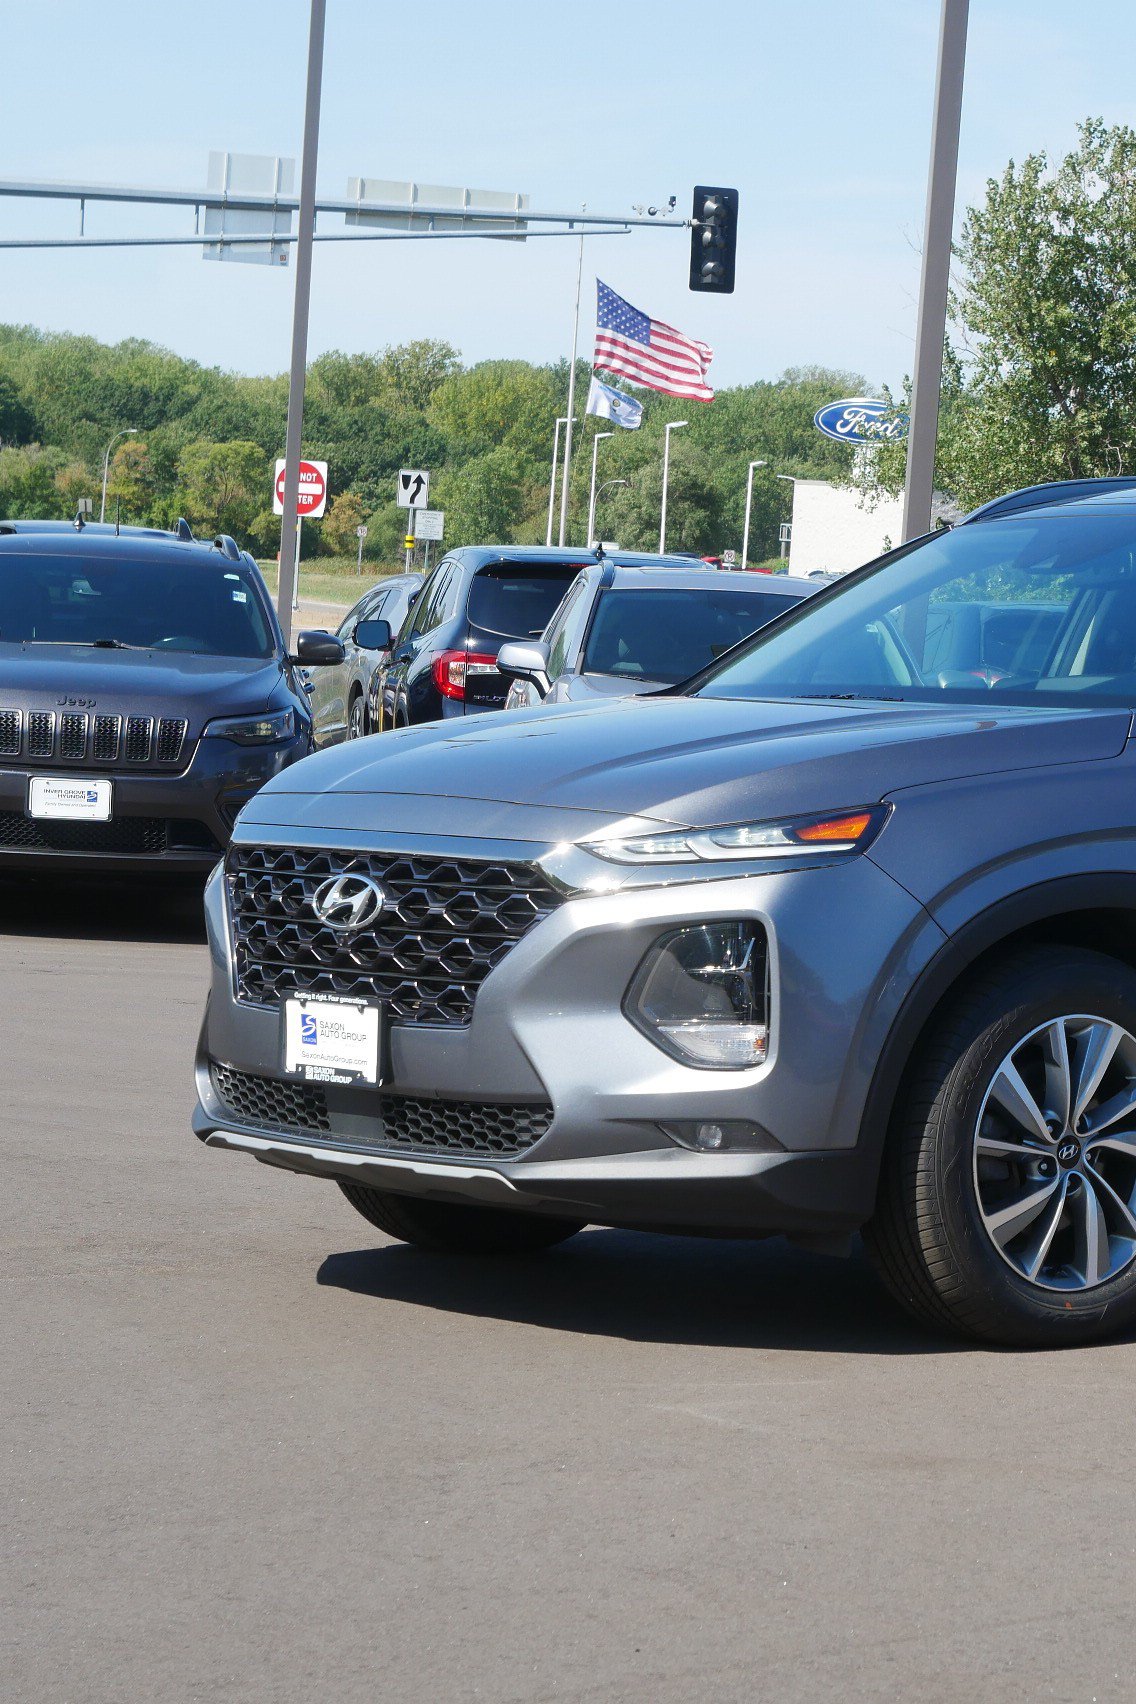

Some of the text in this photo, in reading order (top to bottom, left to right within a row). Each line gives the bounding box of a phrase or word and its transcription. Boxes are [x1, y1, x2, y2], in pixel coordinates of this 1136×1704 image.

[300, 472, 317, 482] NOT
[298, 495, 313, 505] TER
[56, 695, 97, 709] Jeep
[319, 1020, 345, 1031] SAXON
[319, 1030, 367, 1042] AUTO GROUP
[313, 1066, 335, 1075] SAXON
[313, 1073, 353, 1084] AUTO GROUP
